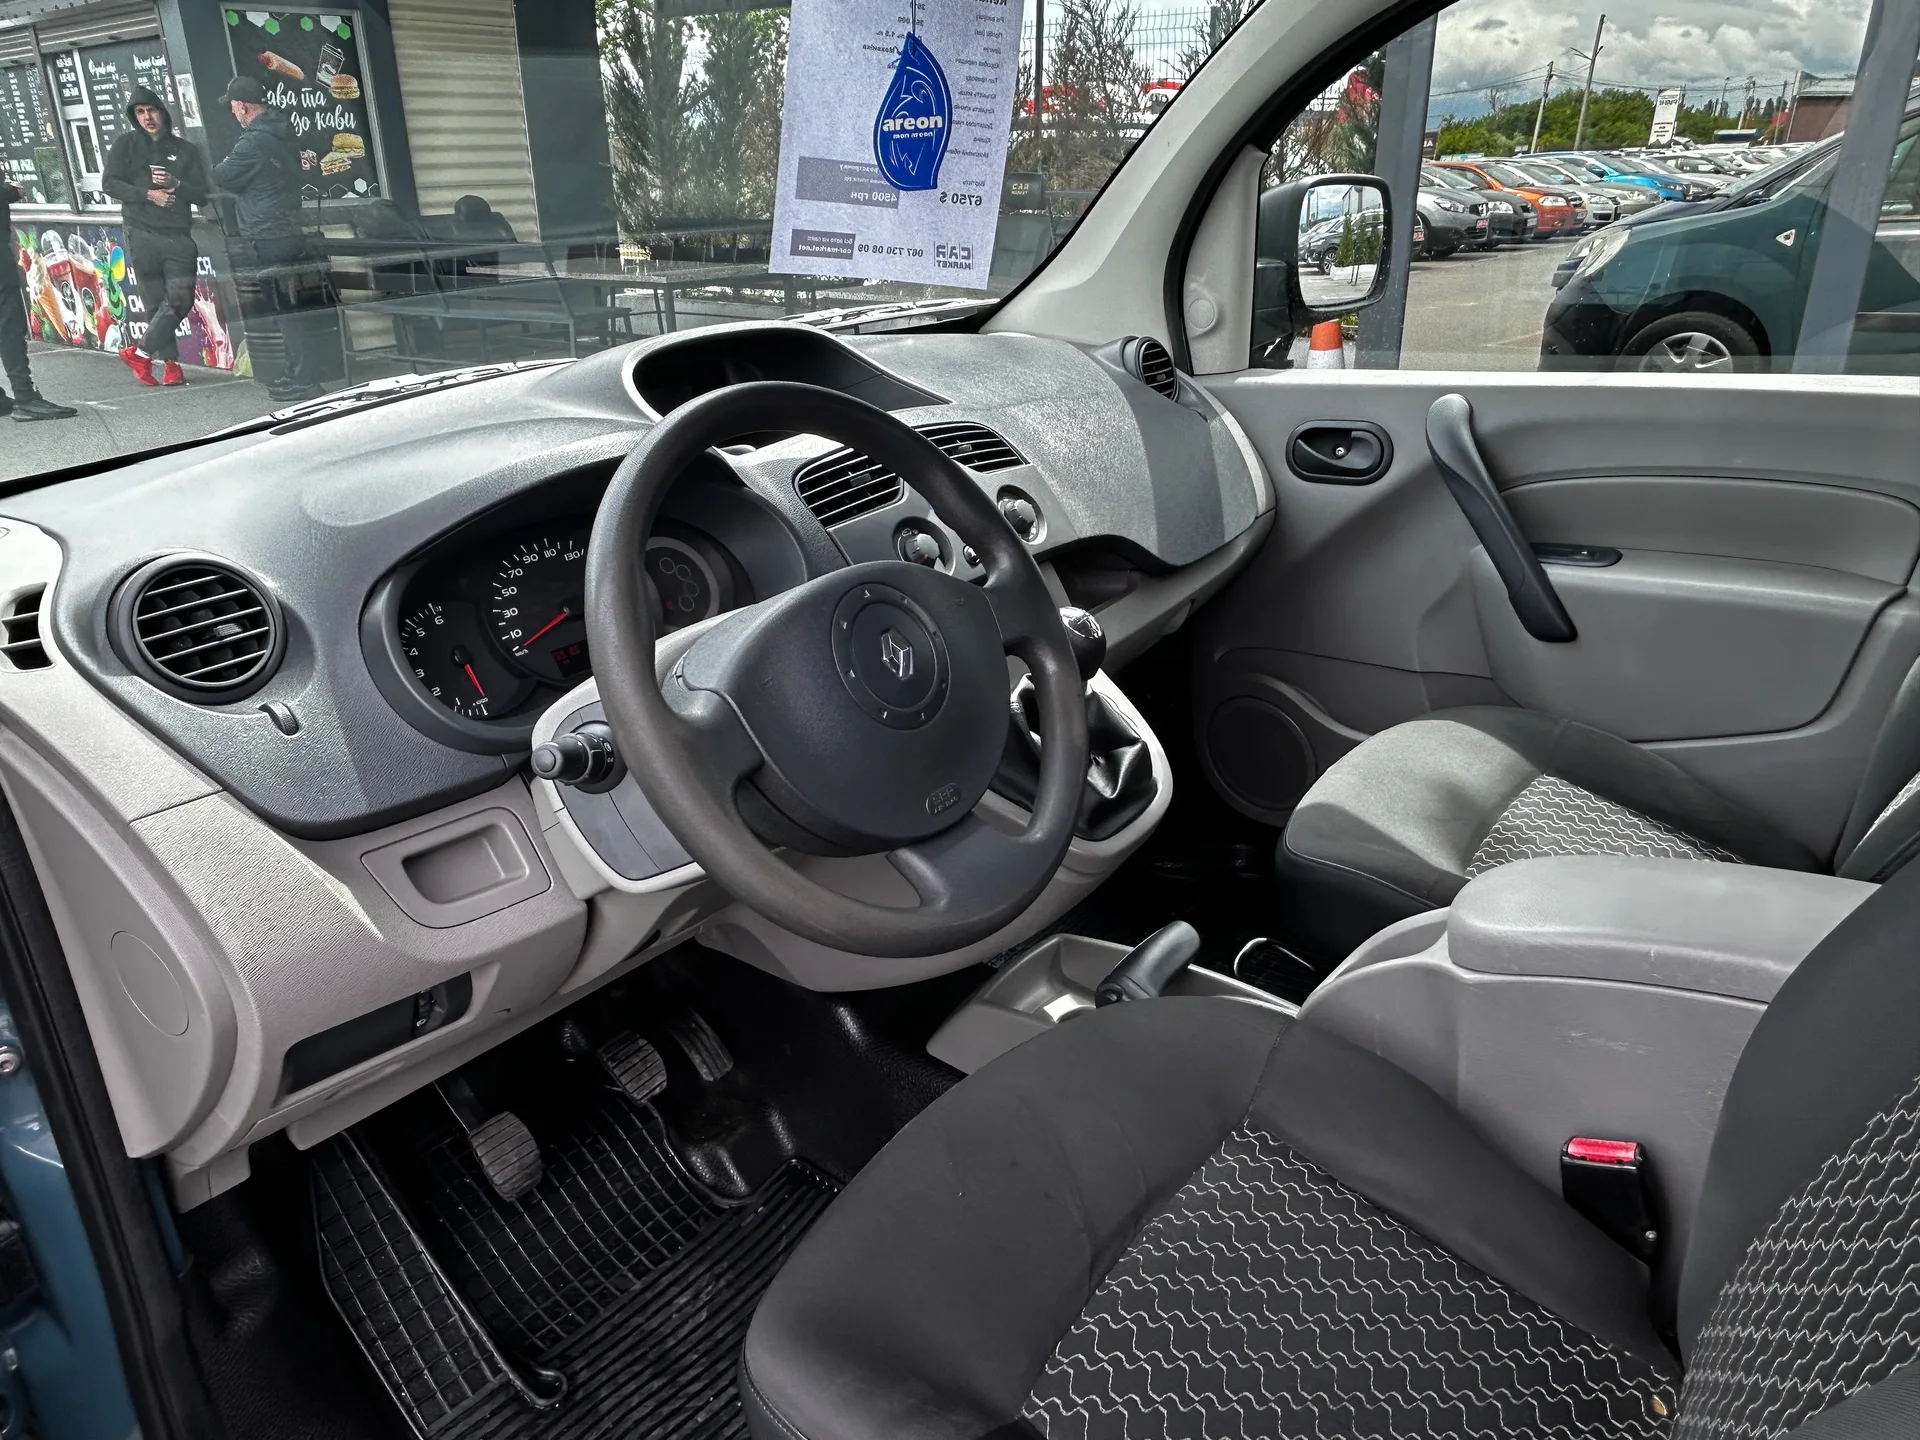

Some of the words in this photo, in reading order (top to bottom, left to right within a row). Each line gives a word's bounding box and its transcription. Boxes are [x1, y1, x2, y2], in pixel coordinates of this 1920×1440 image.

[262, 82, 298, 109] ава
[301, 87, 327, 108] та
[290, 111, 311, 137] до
[315, 104, 357, 131] кави
[882, 115, 943, 132] areon
[522, 553, 539, 564] 90
[543, 548, 557, 558] 110
[564, 550, 580, 561] 130
[508, 568, 524, 578] 70
[501, 586, 518, 597] 50
[502, 607, 519, 618] 30
[434, 615, 444, 625] 6
[415, 627, 426, 637] 5
[509, 628, 522, 639] 10
[409, 647, 419, 656] 4
[415, 668, 425, 679] 3
[431, 686, 442, 697] 2
